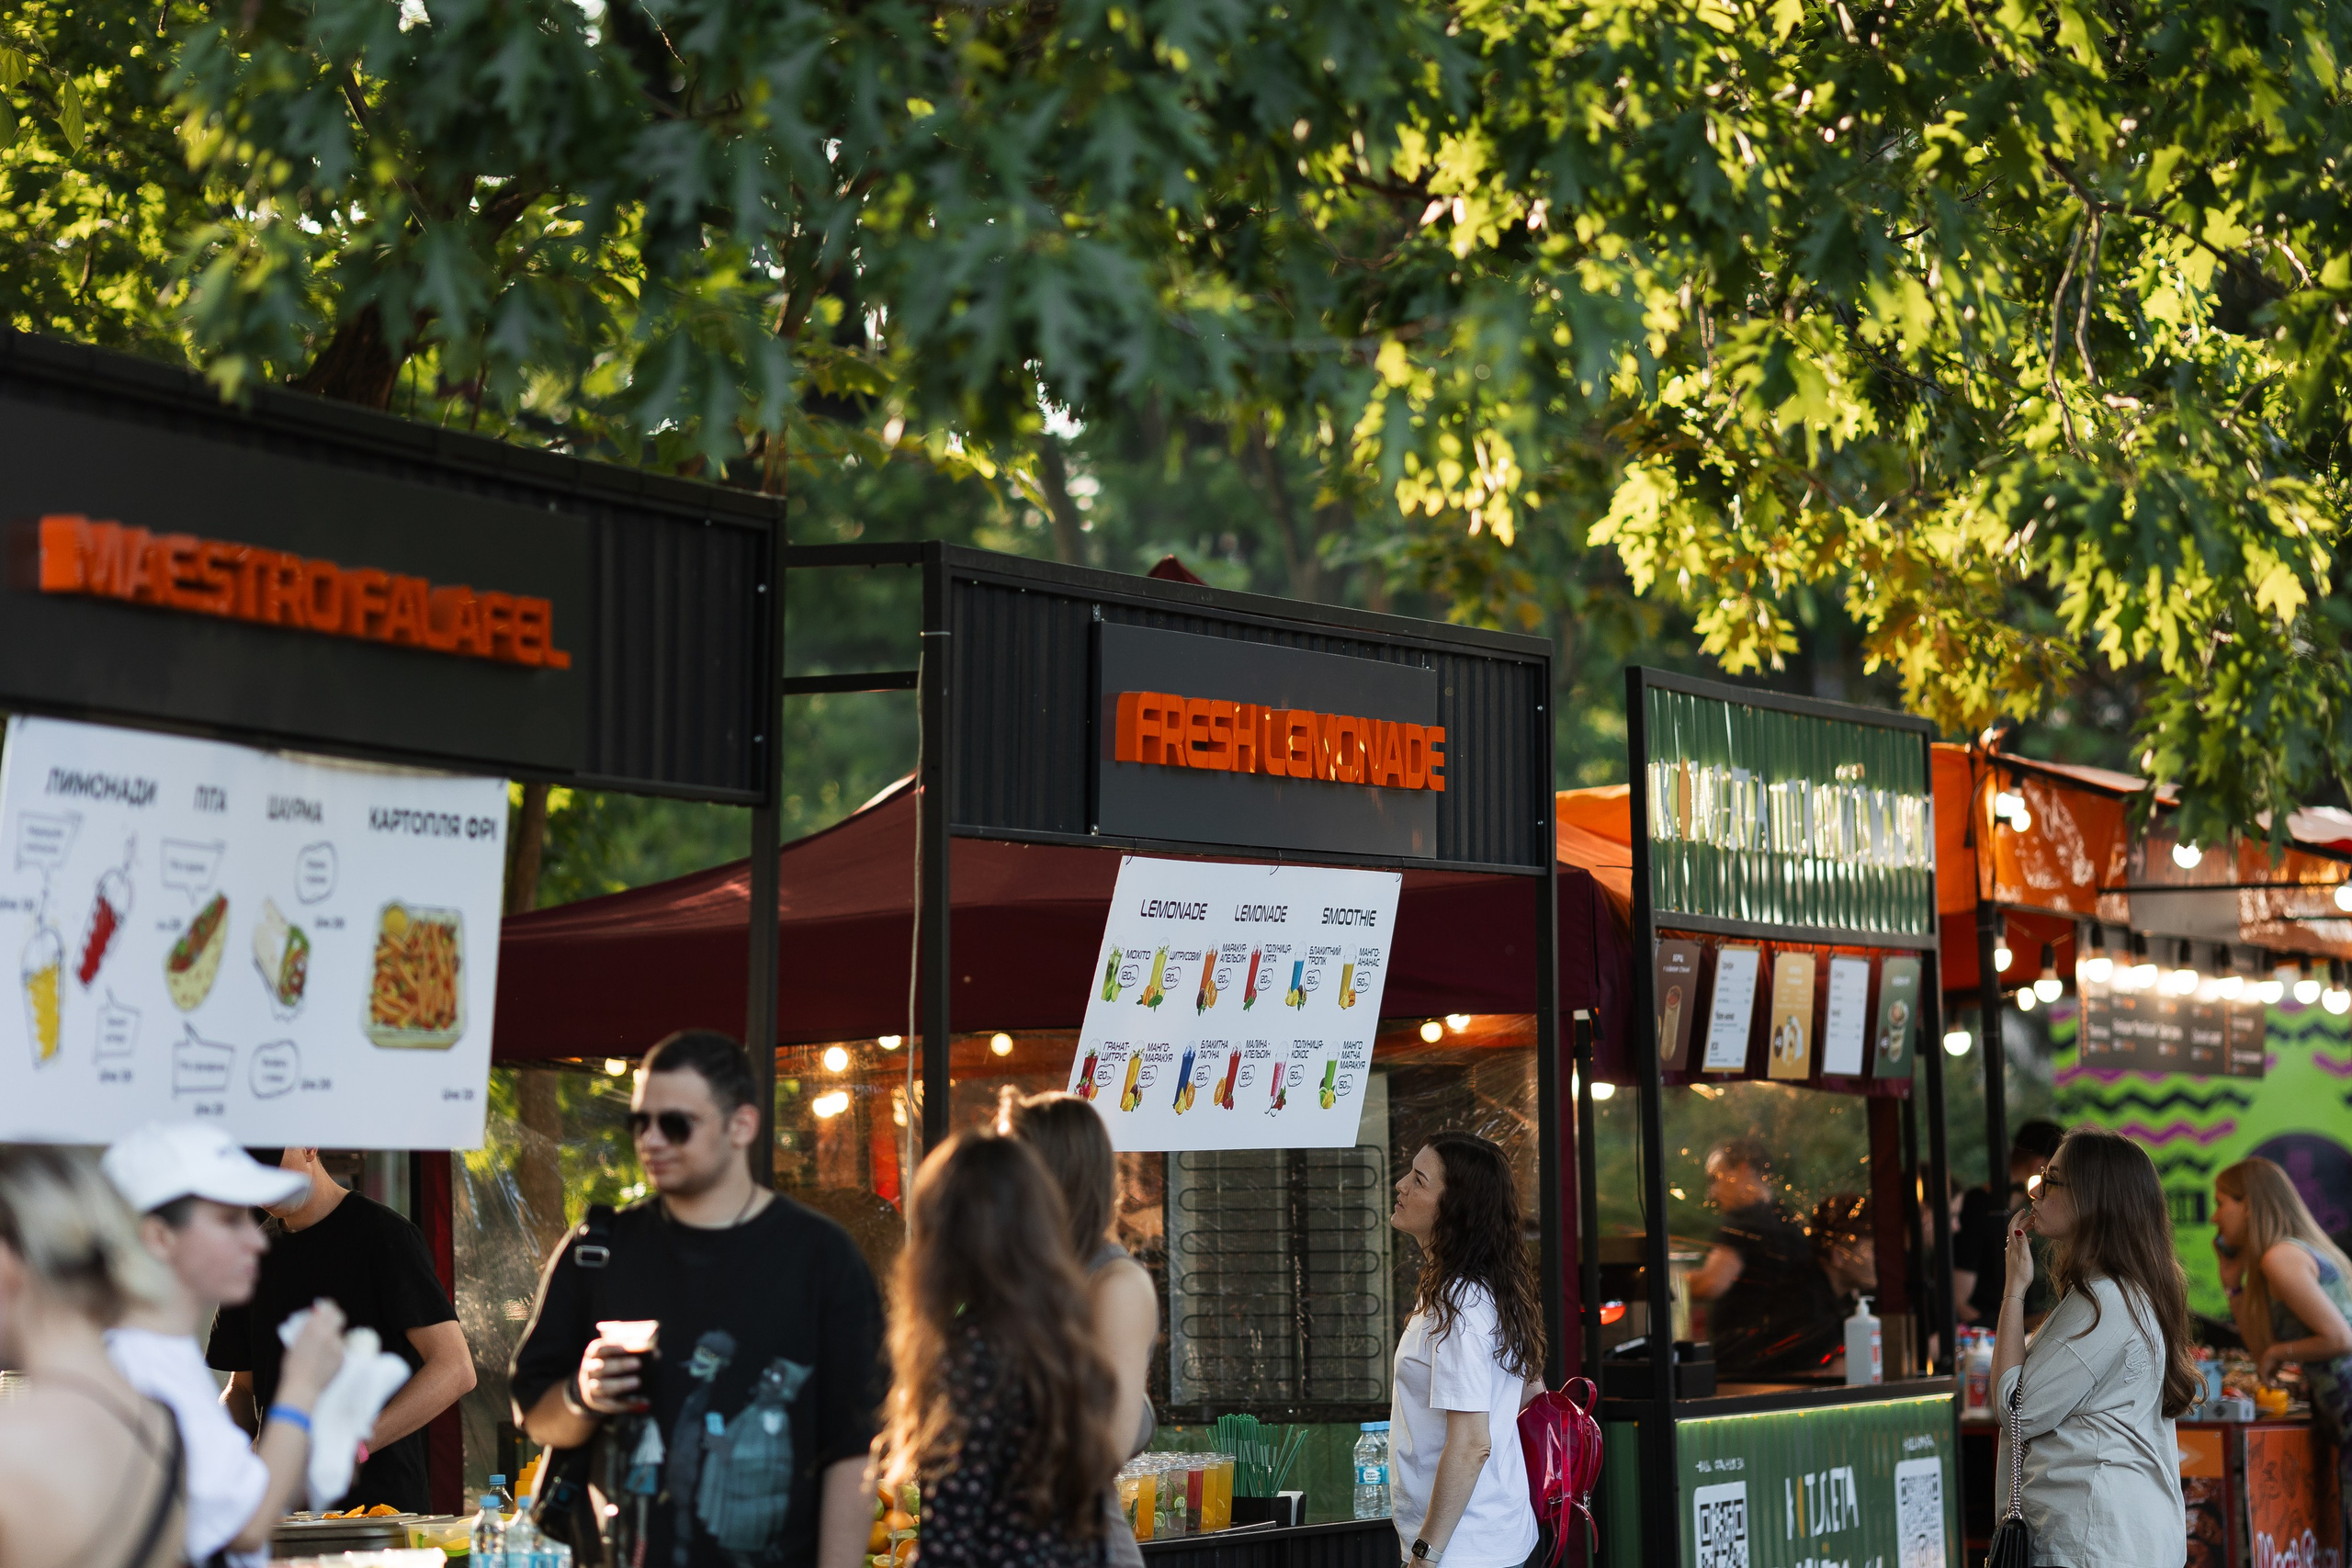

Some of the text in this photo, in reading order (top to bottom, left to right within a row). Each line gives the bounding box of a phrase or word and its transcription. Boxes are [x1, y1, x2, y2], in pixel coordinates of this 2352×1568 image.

[1115, 691, 1446, 792] FRESH LEMONADE
[44, 767, 159, 807] ЛИМОНАДИ
[194, 784, 228, 814] ПІТА
[368, 806, 498, 844] КАРТОПЛЯ ФРІ
[1140, 898, 1208, 921] LEMONADE
[1234, 904, 1288, 923] LEMONADE
[1321, 907, 1377, 927] SMOOTHIE
[1125, 949, 1151, 960] МОХІТО
[1309, 944, 1342, 956] БЛАКИТНИЙ
[1359, 947, 1381, 957] МАНГО-
[1170, 950, 1202, 963] ЦИТРУСОВИЙ
[1219, 953, 1247, 964] АПЕЛЬСИН
[1308, 955, 1328, 965] ТРОПІК
[1356, 957, 1381, 967] АНАНАС
[1102, 1041, 1130, 1051] ГРАНАТ-
[1146, 1042, 1170, 1053] МАНГО-
[1200, 1039, 1229, 1049] БЛАКИТНА
[1342, 1040, 1363, 1050] МАНГО
[1101, 1052, 1128, 1063] ЦИТРУС
[1144, 1053, 1174, 1063] МАРАКУЯ
[1198, 1050, 1220, 1060] ЛАГУНА
[1243, 1049, 1272, 1059] АПЕЛЬСИН
[1291, 1049, 1310, 1059] КОКОС
[1340, 1050, 1361, 1060] МАТЧА
[1339, 1060, 1366, 1070] МАРАКУЯ
